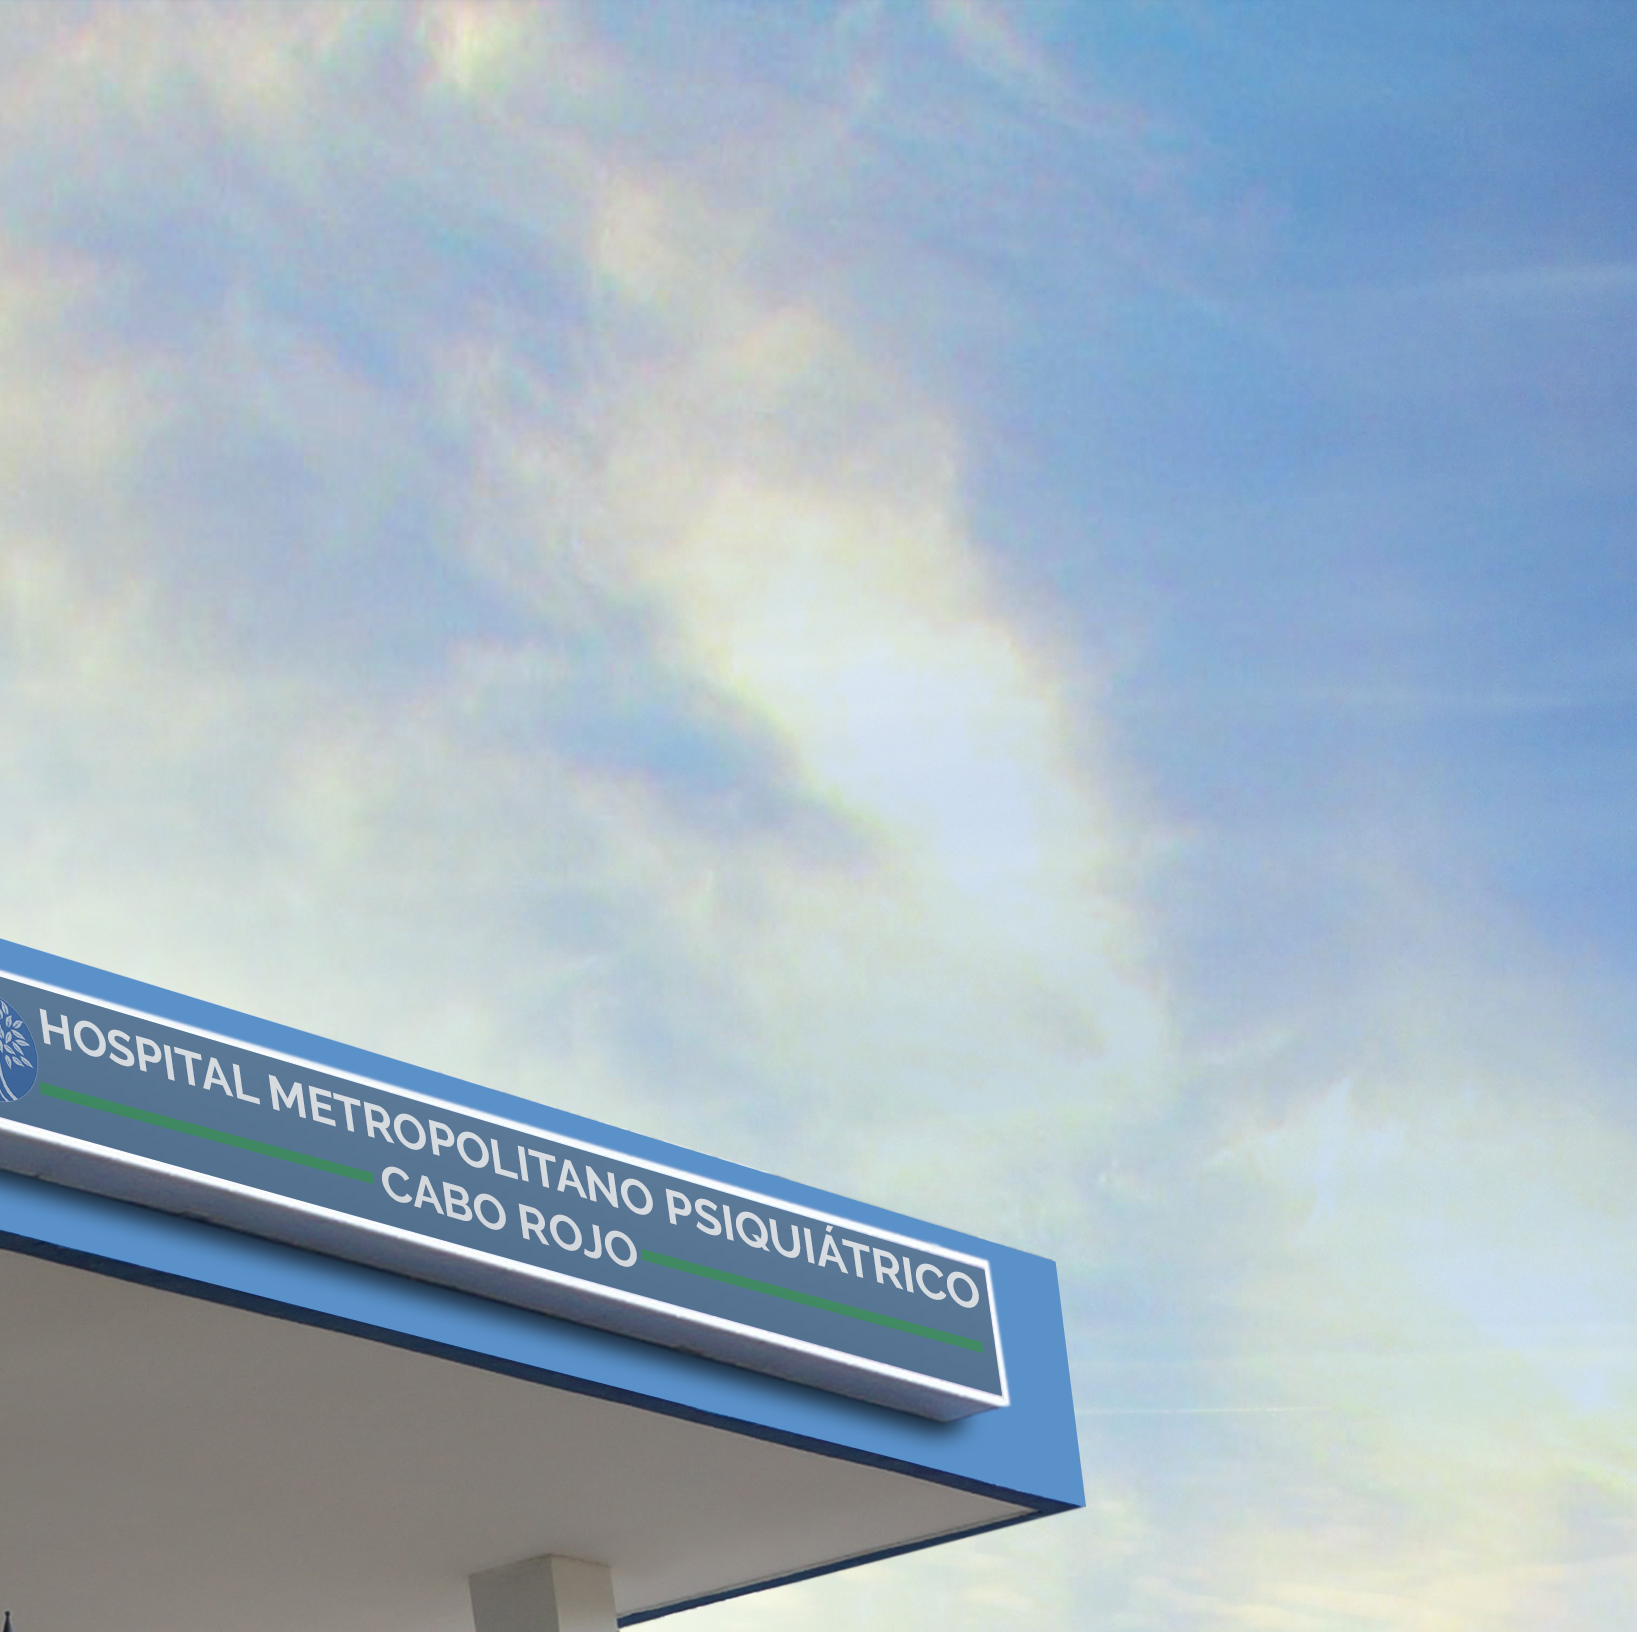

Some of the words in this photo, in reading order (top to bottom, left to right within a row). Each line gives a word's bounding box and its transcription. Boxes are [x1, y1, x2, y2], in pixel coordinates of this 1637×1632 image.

[39, 1008, 261, 1105] HOSPITAL
[268, 1074, 654, 1216] METROPOLITANO
[665, 1188, 980, 1309] PSIQUIÁTRICO
[381, 1166, 507, 1231] CABO
[518, 1203, 638, 1268] ROJO
